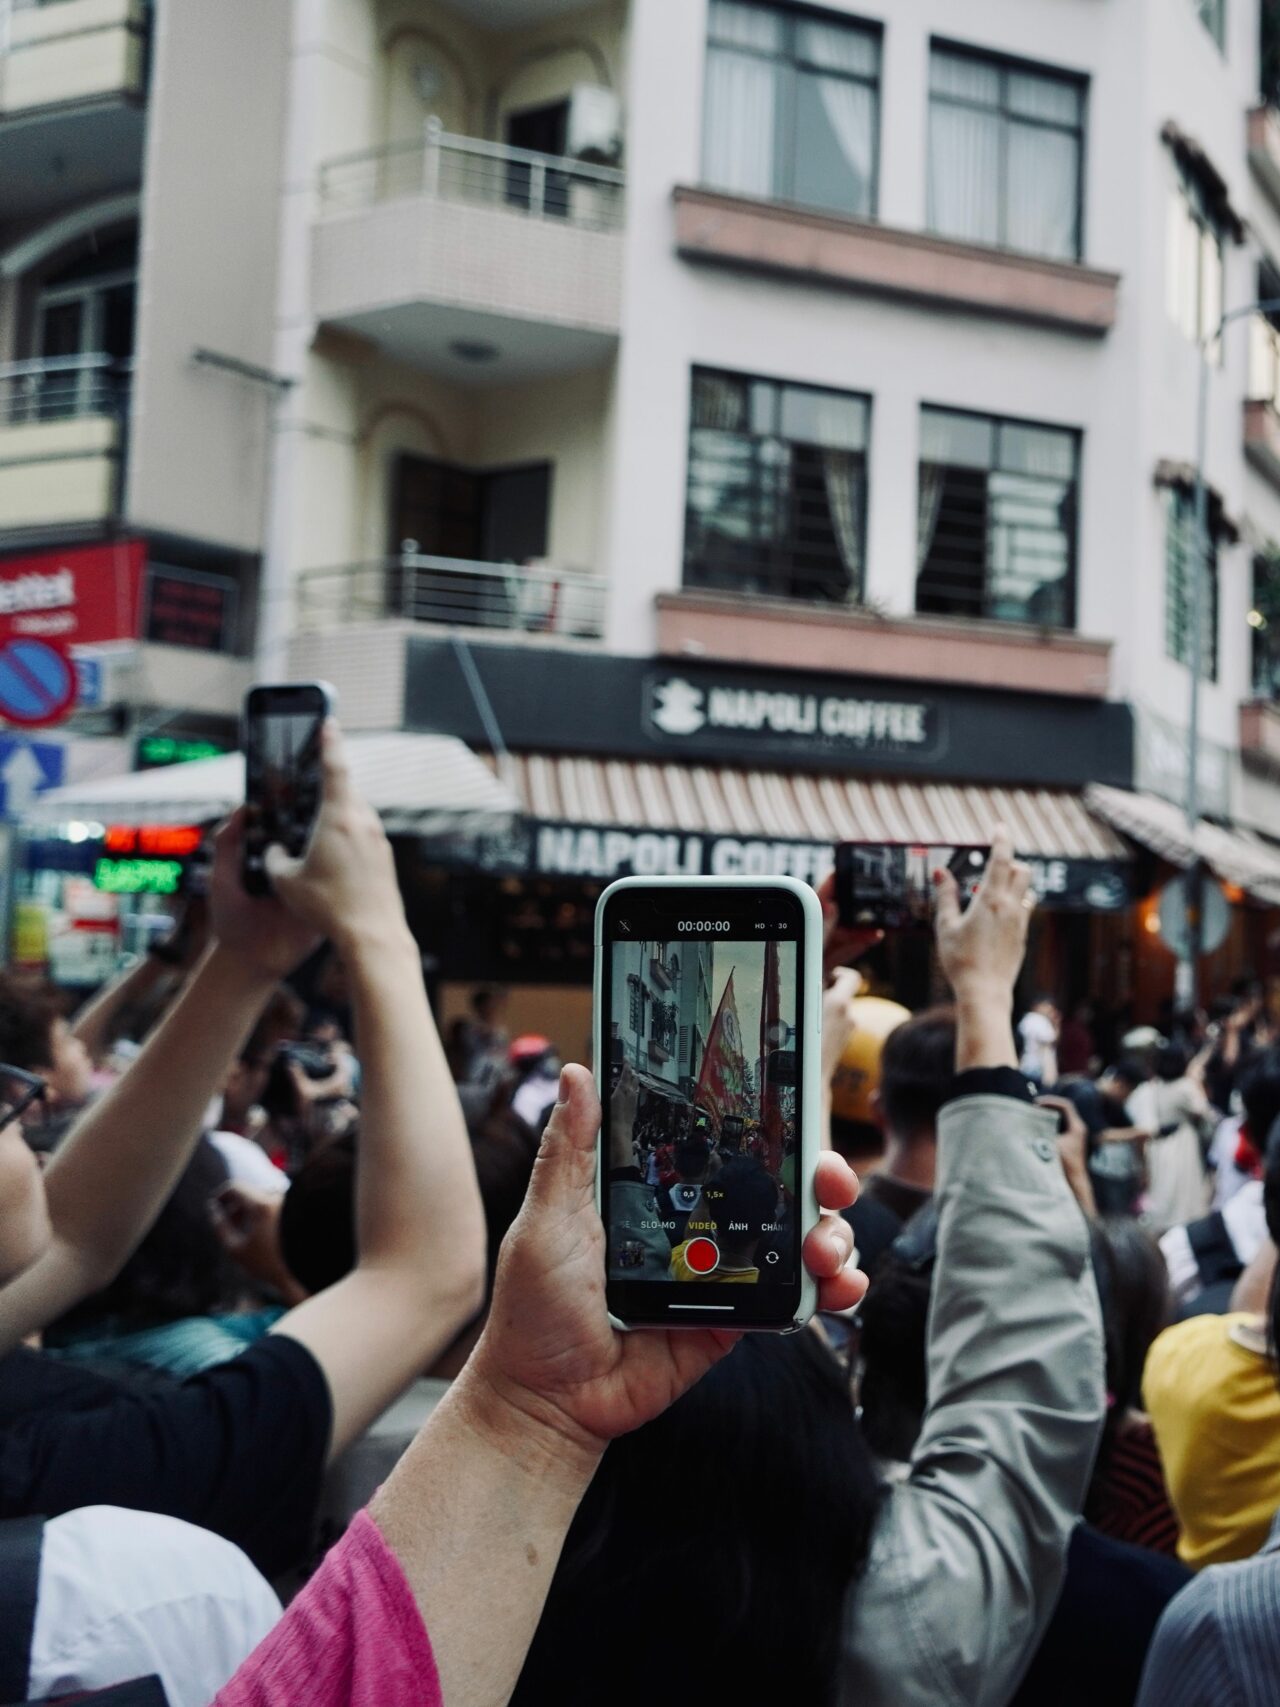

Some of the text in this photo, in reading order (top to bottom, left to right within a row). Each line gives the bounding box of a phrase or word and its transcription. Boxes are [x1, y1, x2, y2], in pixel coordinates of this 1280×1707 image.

[708, 685, 926, 743] NAPOLI COFFEE
[536, 826, 703, 878] NAPOLI
[677, 921, 731, 932] 00:00:00
[640, 1220, 676, 1230] SLO-MO
[688, 1221, 718, 1230] VIDEO
